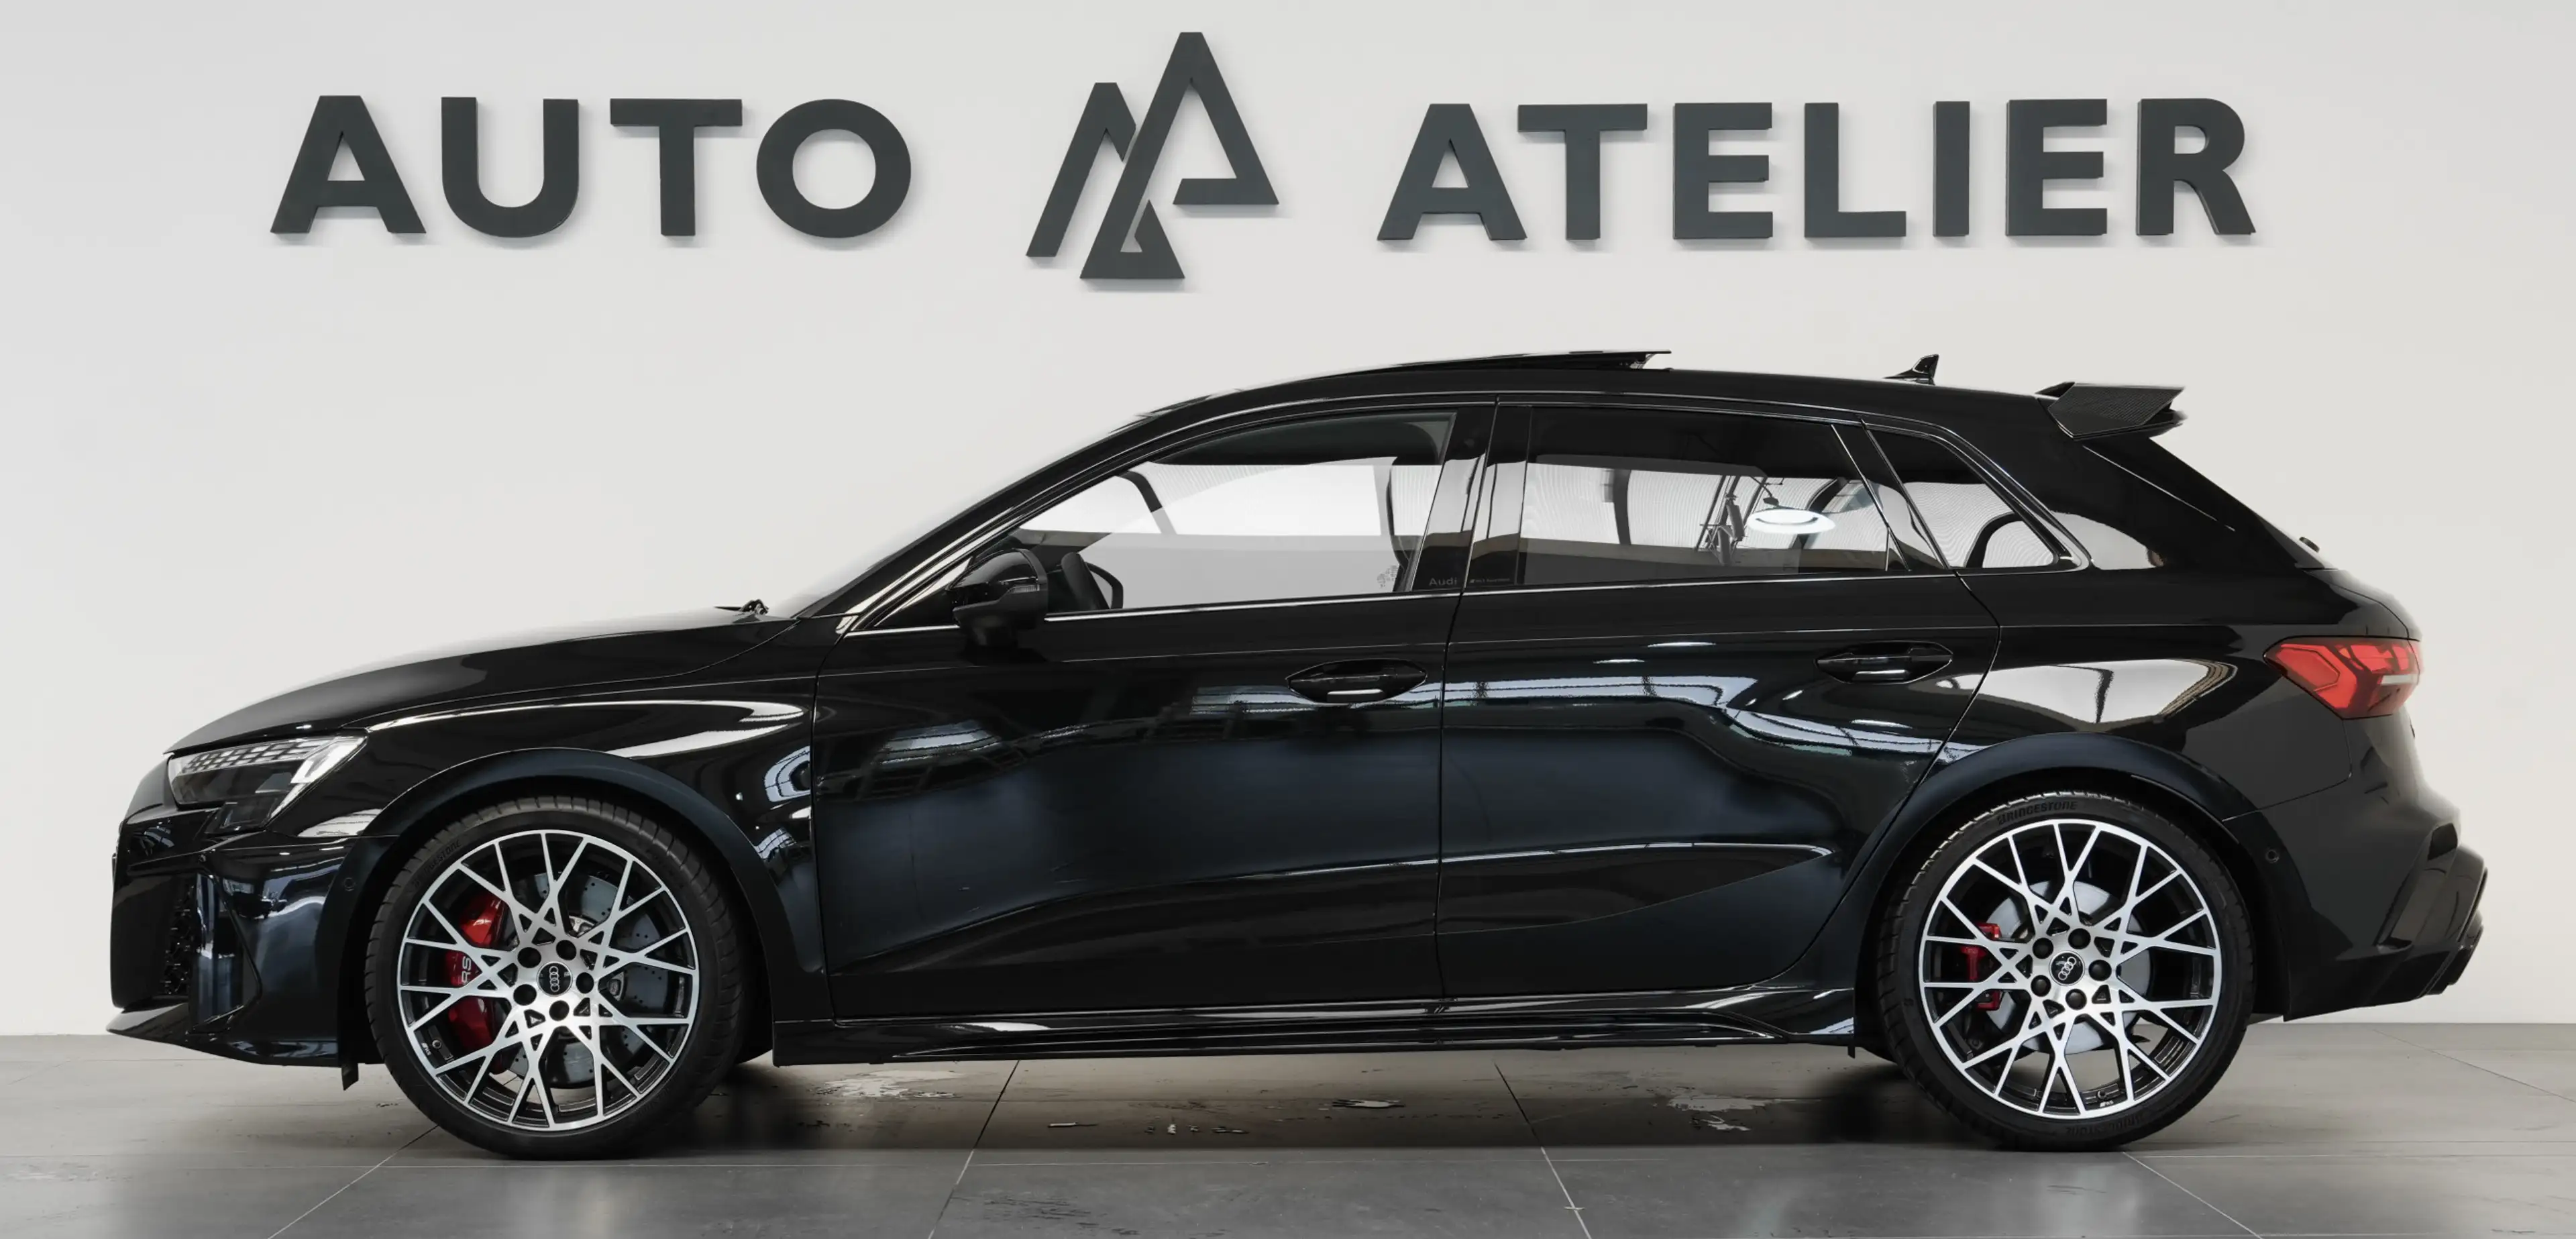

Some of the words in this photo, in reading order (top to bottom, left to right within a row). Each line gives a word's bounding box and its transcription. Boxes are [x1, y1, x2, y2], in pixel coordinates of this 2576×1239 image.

[270, 96, 911, 239] AUTO
[1377, 96, 2256, 241] ATELIER
[1428, 577, 1458, 586] Audi
[462, 956, 472, 984] RS
